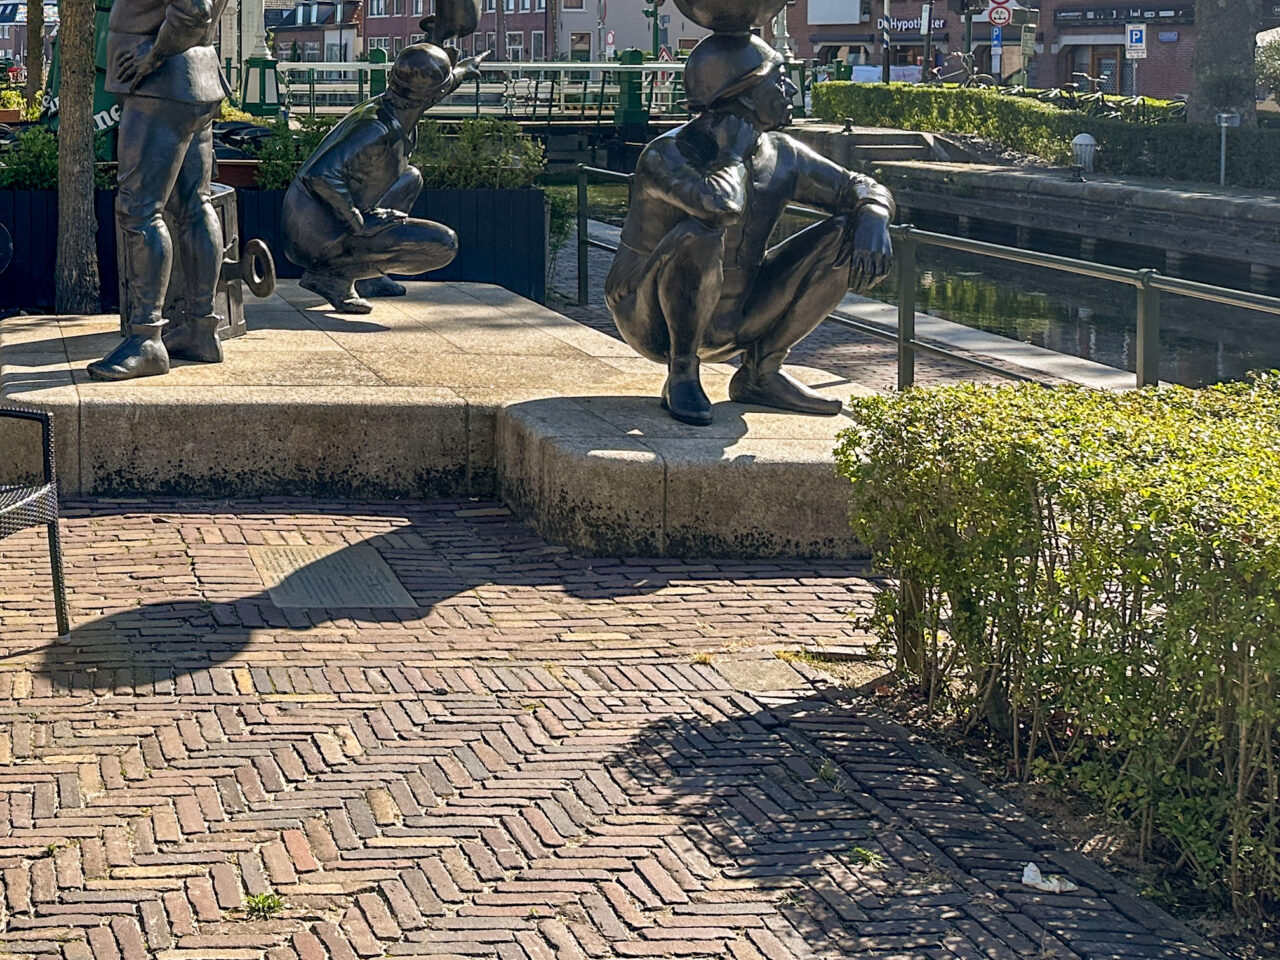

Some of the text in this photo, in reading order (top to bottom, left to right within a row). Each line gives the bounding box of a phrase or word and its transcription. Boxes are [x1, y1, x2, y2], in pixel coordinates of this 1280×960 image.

[890, 17, 945, 31] Hypother
[993, 28, 999, 38] P
[1132, 31, 1141, 43] P
